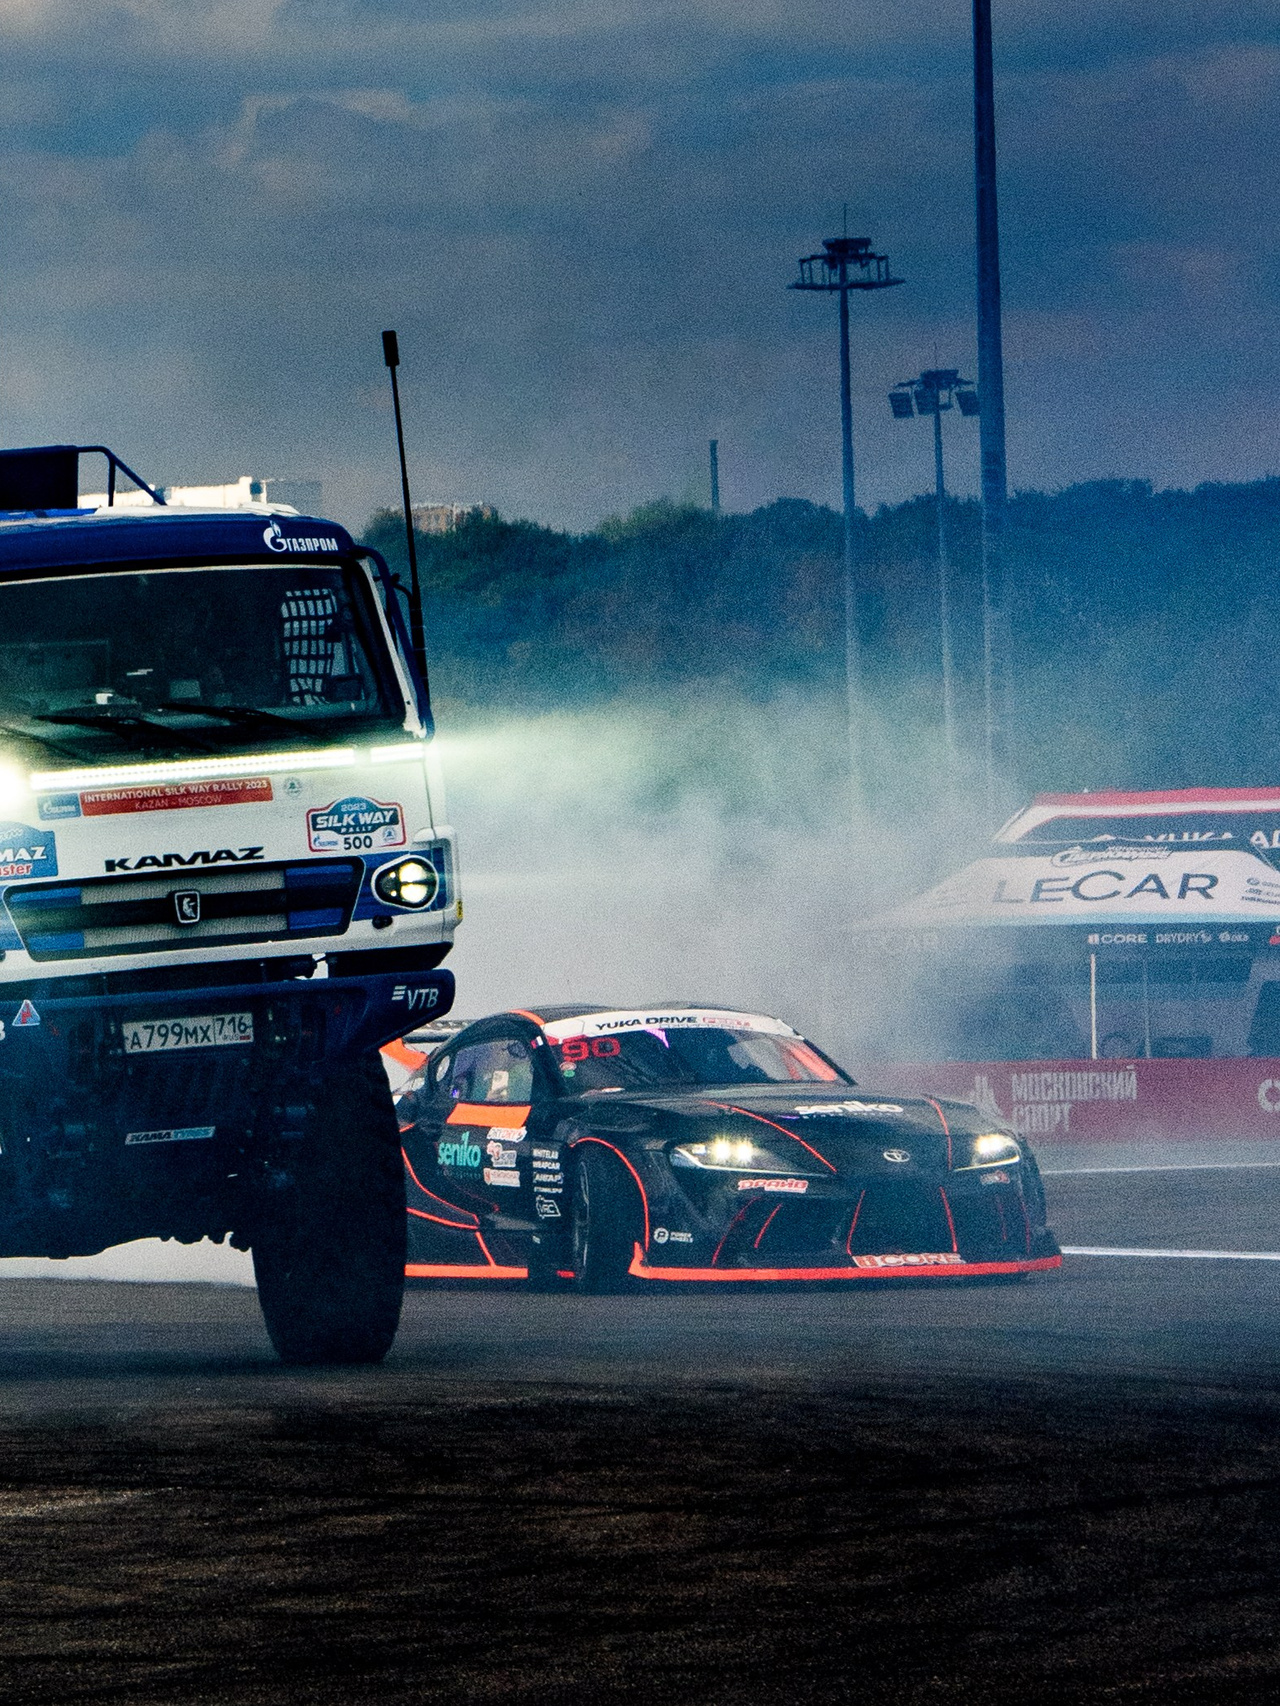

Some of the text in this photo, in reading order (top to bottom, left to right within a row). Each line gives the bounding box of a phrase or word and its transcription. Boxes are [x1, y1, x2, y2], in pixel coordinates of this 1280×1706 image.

[287, 538, 338, 551] ГАЗПРОМ
[84, 780, 268, 804] INTERNATIONAL SILK WAY RALLY 2023
[135, 799, 169, 810] KAZAN
[178, 795, 221, 806] MOSCOW
[341, 802, 367, 812] 2023
[316, 810, 394, 829] SILK WAY
[340, 825, 373, 834] RALLY
[343, 835, 373, 850] 500
[105, 846, 264, 873] KAMAZ
[992, 870, 1219, 903] LECAR
[1101, 933, 1148, 944] CORE
[406, 987, 439, 1011] VTB
[216, 1016, 247, 1036] 716
[596, 1018, 642, 1031] YUKA
[645, 1015, 697, 1026] DRIVE
[561, 1037, 621, 1063] 90
[1012, 1065, 1137, 1101] МОСКОВСКИЙ
[795, 1100, 904, 1115] seniko
[437, 1131, 482, 1168] seniko
